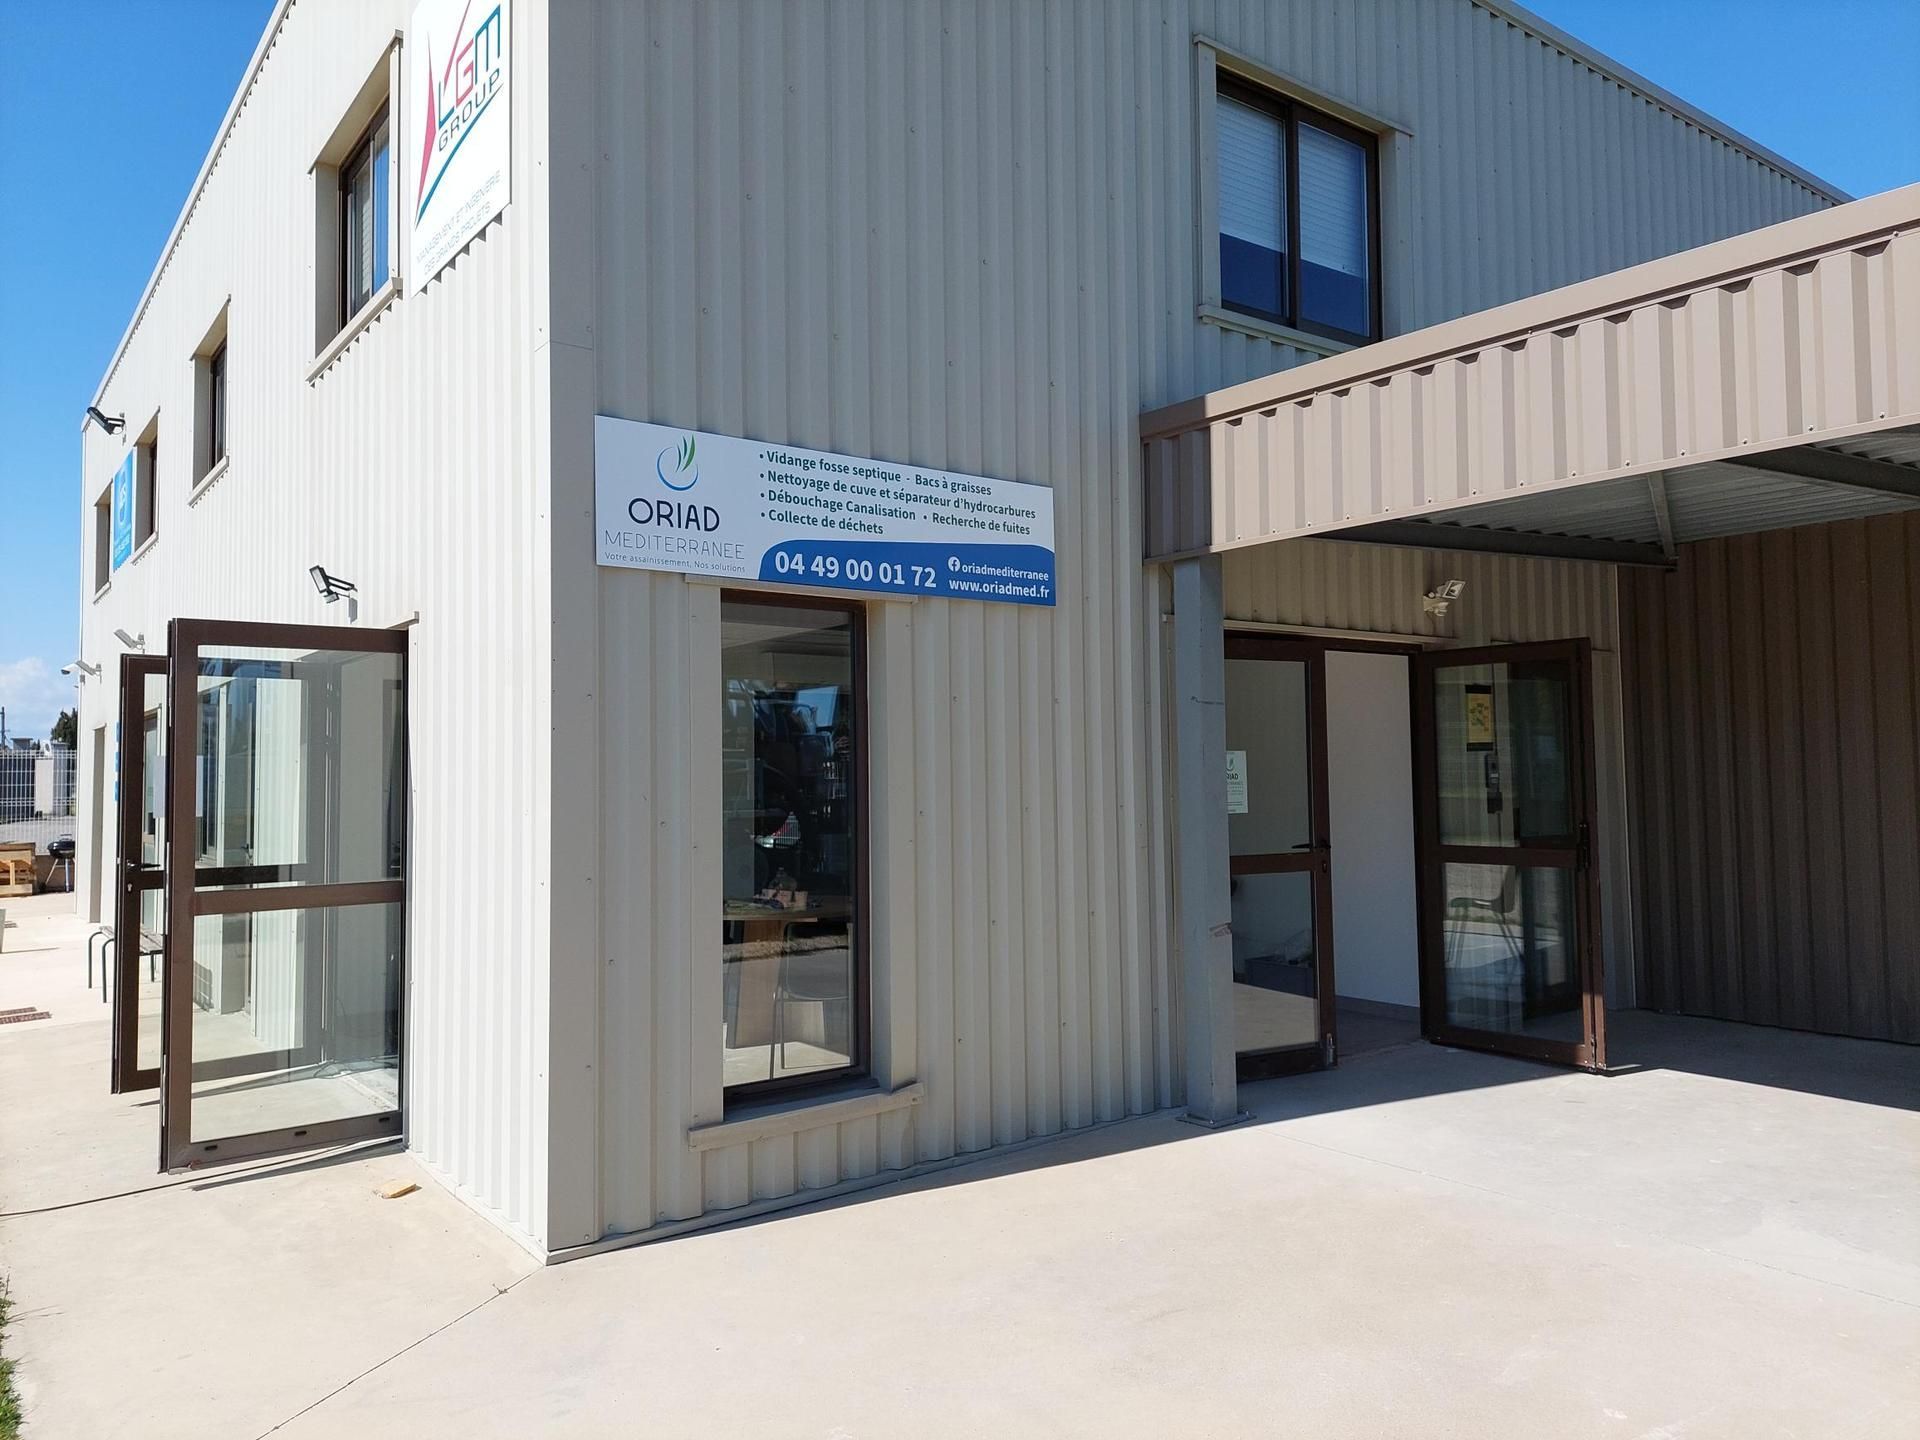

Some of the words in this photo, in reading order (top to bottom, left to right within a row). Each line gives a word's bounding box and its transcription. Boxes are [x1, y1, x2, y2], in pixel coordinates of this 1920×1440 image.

[438, 68, 500, 152] GROUP
[767, 450, 816, 471] Vidange
[819, 459, 849, 474] fosse
[852, 466, 901, 482] septique
[915, 474, 940, 488] Bacs
[942, 476, 948, 489] à
[951, 481, 992, 496] graisses
[768, 470, 830, 492] Nettoyage
[833, 480, 847, 493] de
[850, 484, 877, 497] cuve
[879, 489, 891, 499] et
[893, 488, 951, 507] séparateur
[954, 498, 1036, 519] d’hydrocarbures
[628, 498, 720, 532] ORIAD
[768, 489, 843, 512] Débouchage
[846, 501, 916, 520] Canalisation
[932, 512, 986, 530] Recherche
[988, 520, 1000, 531] de
[1003, 521, 1031, 535] fuites
[769, 509, 818, 526] Collecte
[821, 516, 836, 528] de
[839, 517, 884, 535] déchets
[605, 530, 745, 560] MEDITERRANEE
[604, 552, 627, 562] Votre
[694, 560, 709, 570] Nos
[711, 563, 746, 573] solutions
[775, 551, 806, 575] 04
[811, 555, 840, 579] 49
[846, 559, 873, 582] 00
[879, 562, 906, 585] 01
[910, 565, 937, 588] 72
[962, 563, 1049, 581] oriadmediterranee
[949, 580, 1050, 599] www.oriadmed.fr
